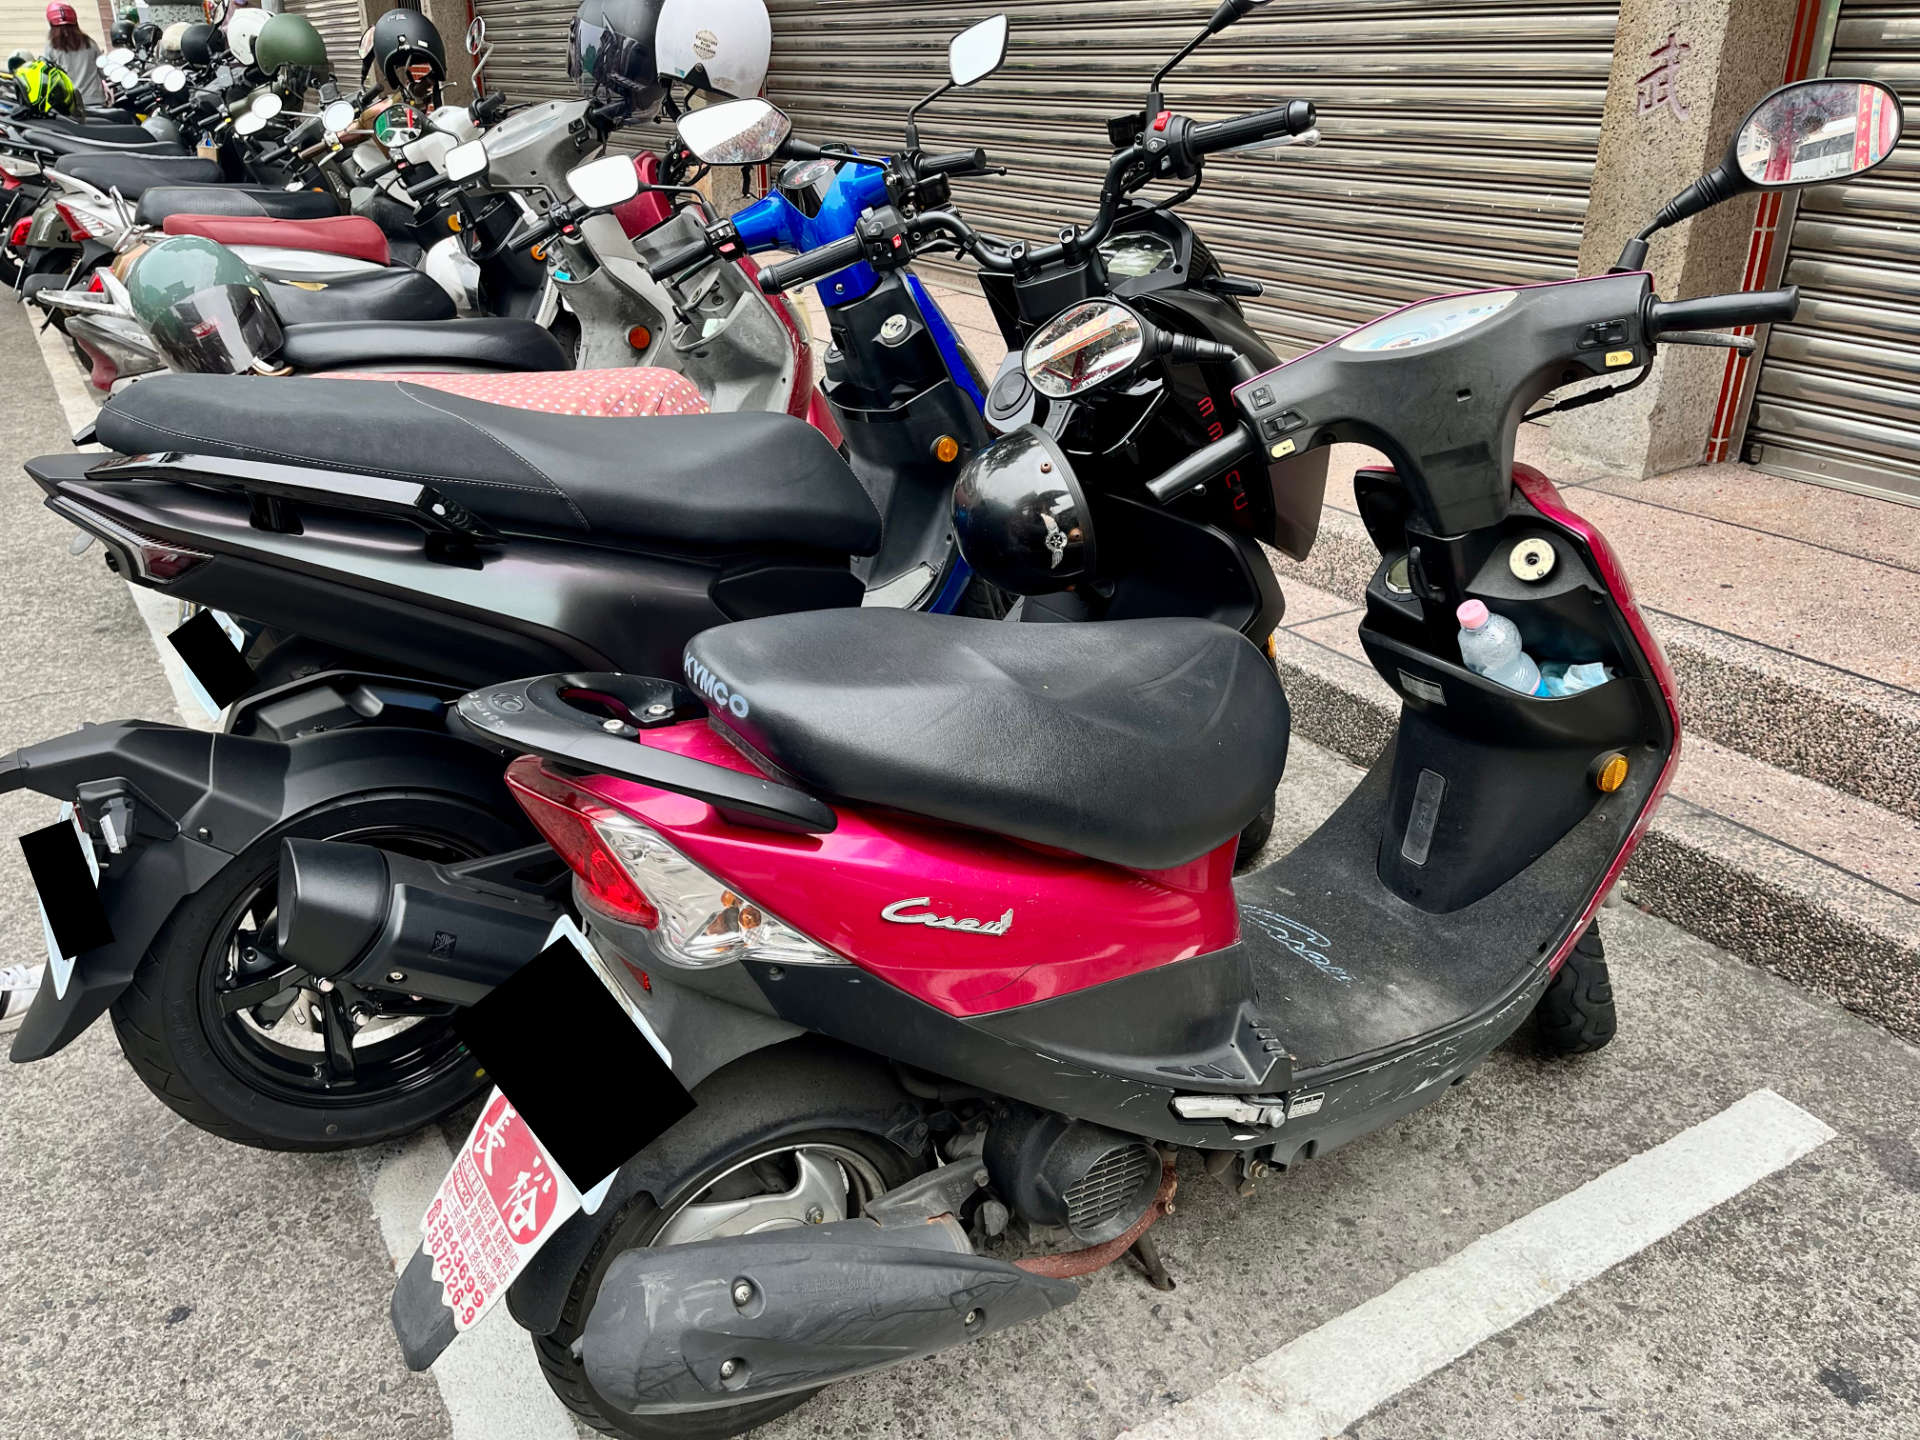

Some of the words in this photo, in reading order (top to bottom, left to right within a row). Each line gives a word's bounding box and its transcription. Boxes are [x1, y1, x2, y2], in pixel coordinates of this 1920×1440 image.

[1635, 32, 1690, 121] 武
[684, 651, 750, 719] KYMCO
[474, 1102, 553, 1235] 長裕
[427, 1231, 477, 1325] 3872126-9
[439, 1213, 485, 1308] 3843699
